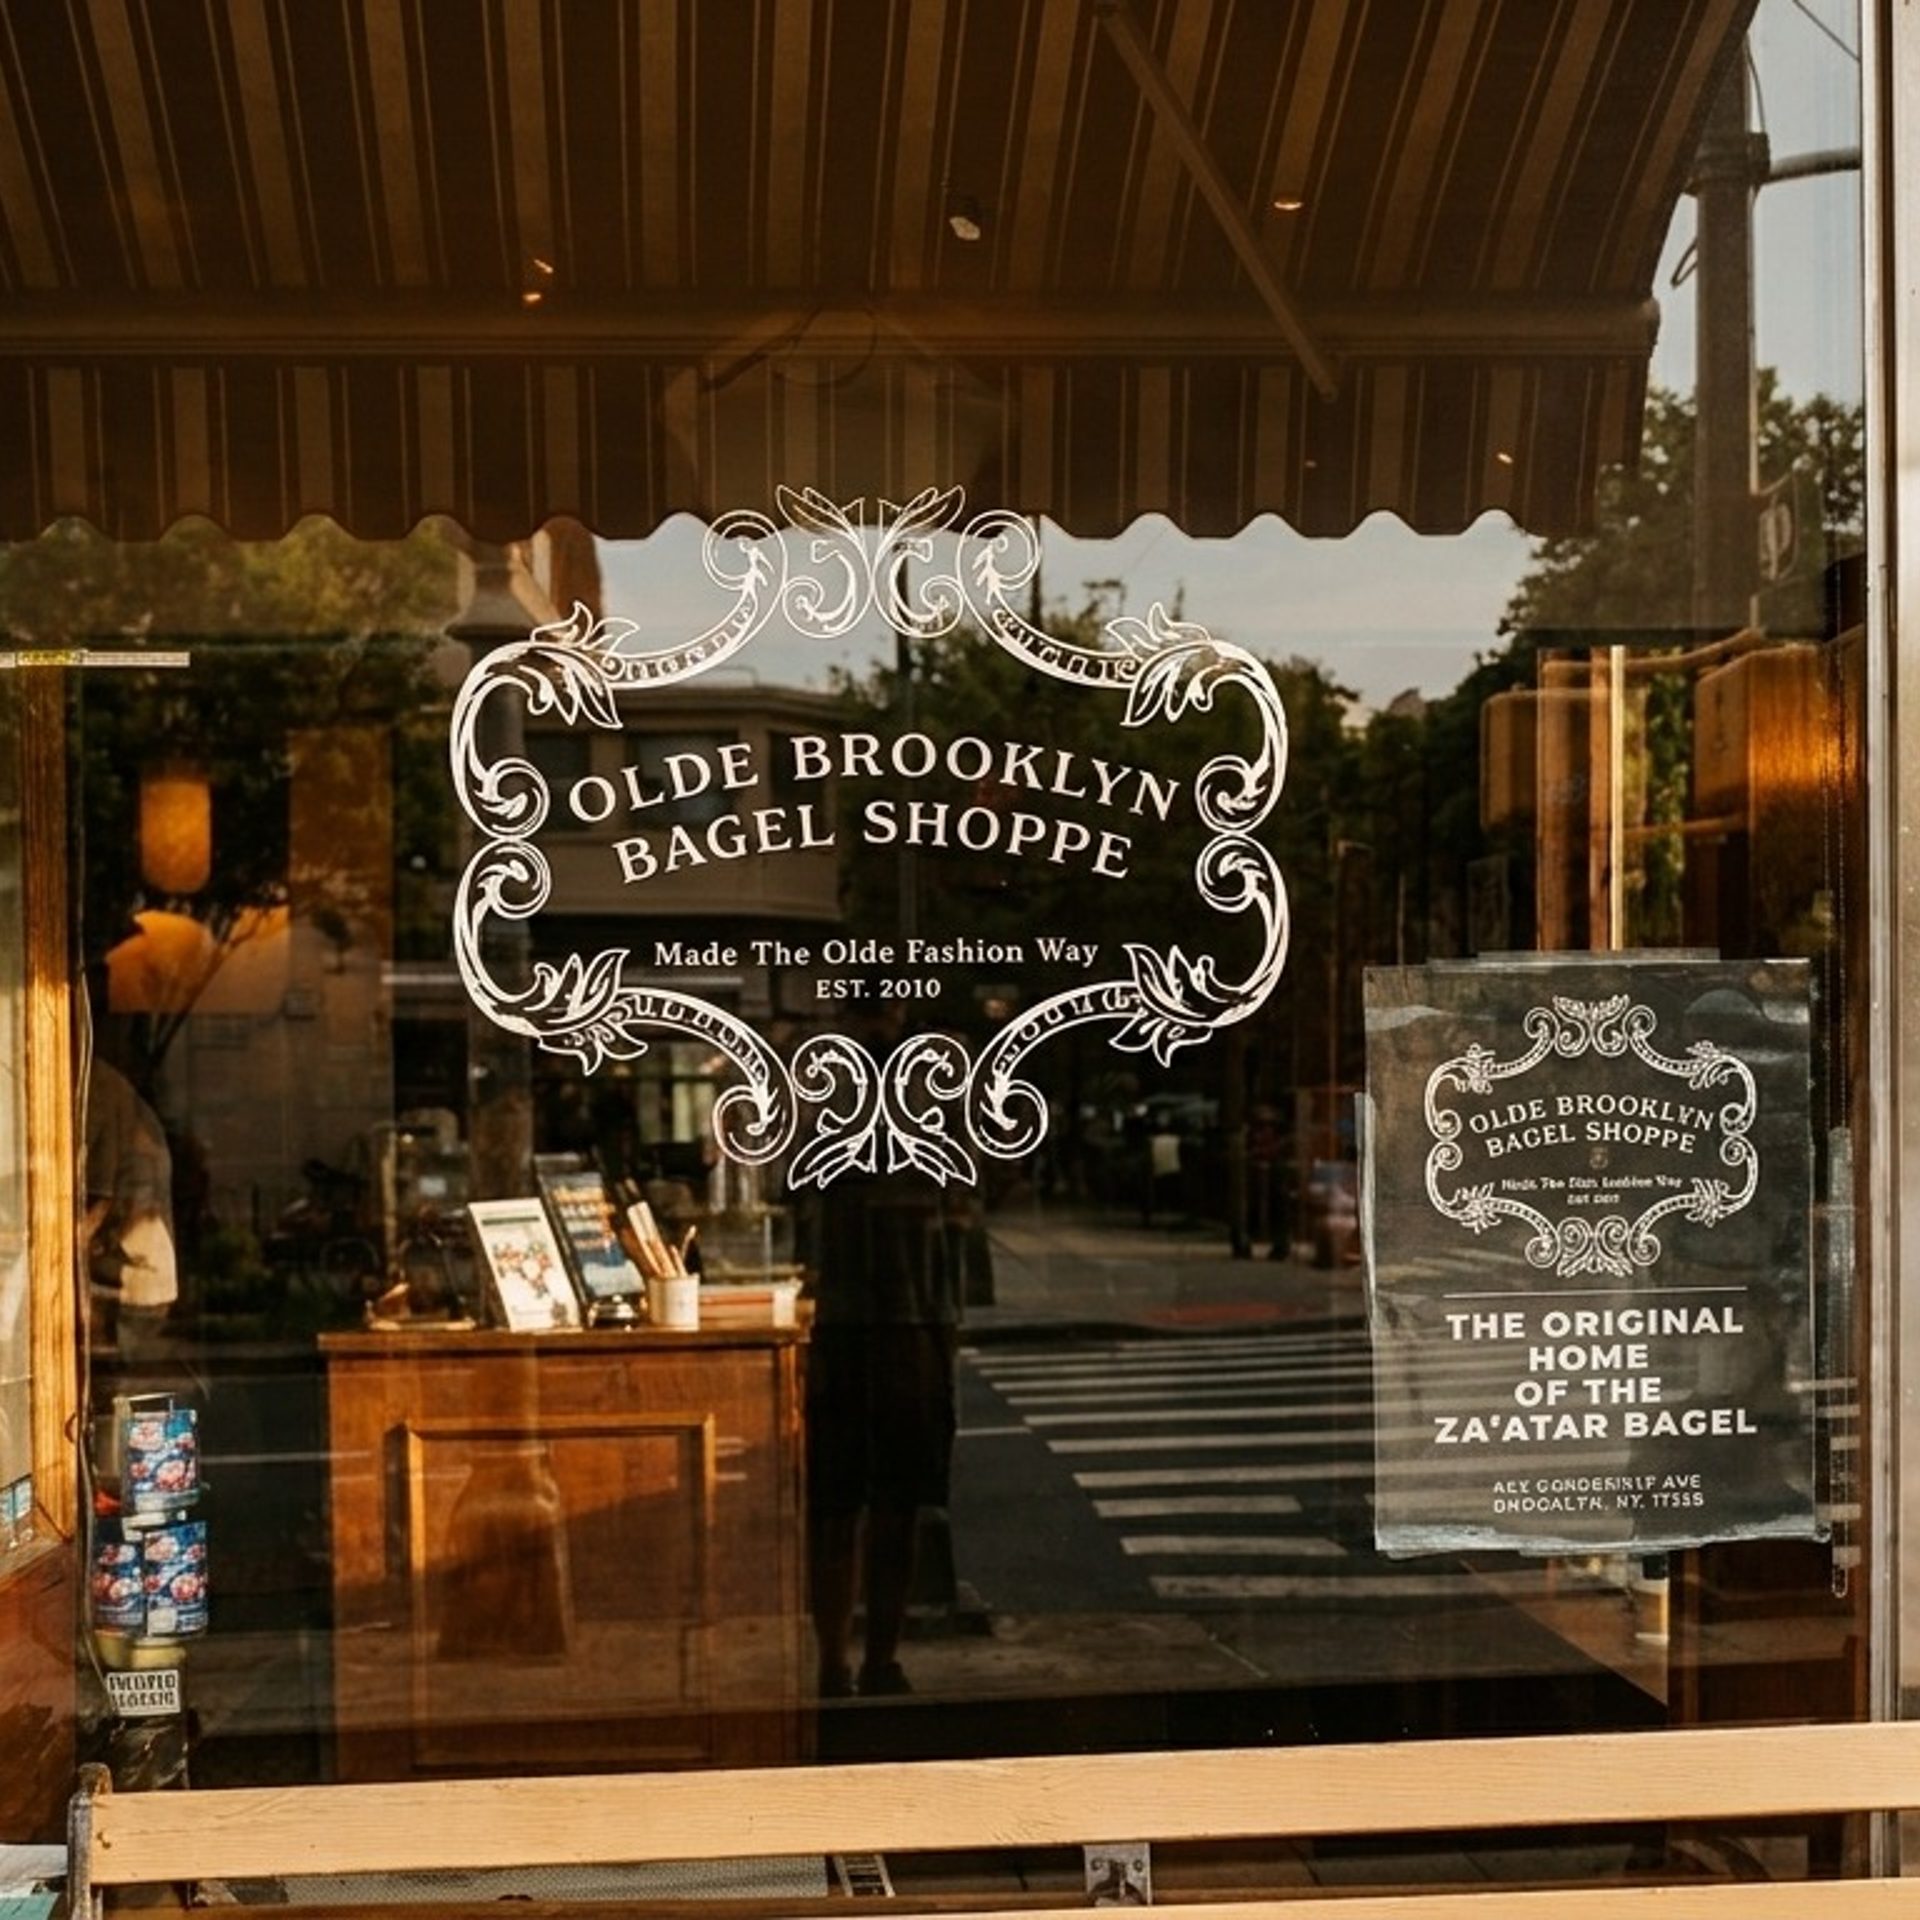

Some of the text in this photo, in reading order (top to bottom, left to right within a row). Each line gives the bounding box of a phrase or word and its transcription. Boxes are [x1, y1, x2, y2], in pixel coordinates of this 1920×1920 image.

[569, 733, 1180, 823] OLDE BROOKLYN
[612, 800, 1132, 884] BAGEL SHOPPE
[654, 936, 1099, 967] Made The Olde Fashion Way
[816, 979, 941, 999] EST. 2010
[1469, 1094, 1714, 1133] OLDE BROOKLYN
[1485, 1120, 1697, 1158] BAGEL SHOPPE
[1446, 1307, 1744, 1341] THE ORIGINAL
[1529, 1344, 1649, 1371] HOME
[1514, 1377, 1661, 1407] OF THE
[1434, 1409, 1758, 1444] ZA'ATAR BAGEL
[1662, 1474, 1701, 1489] AVE
